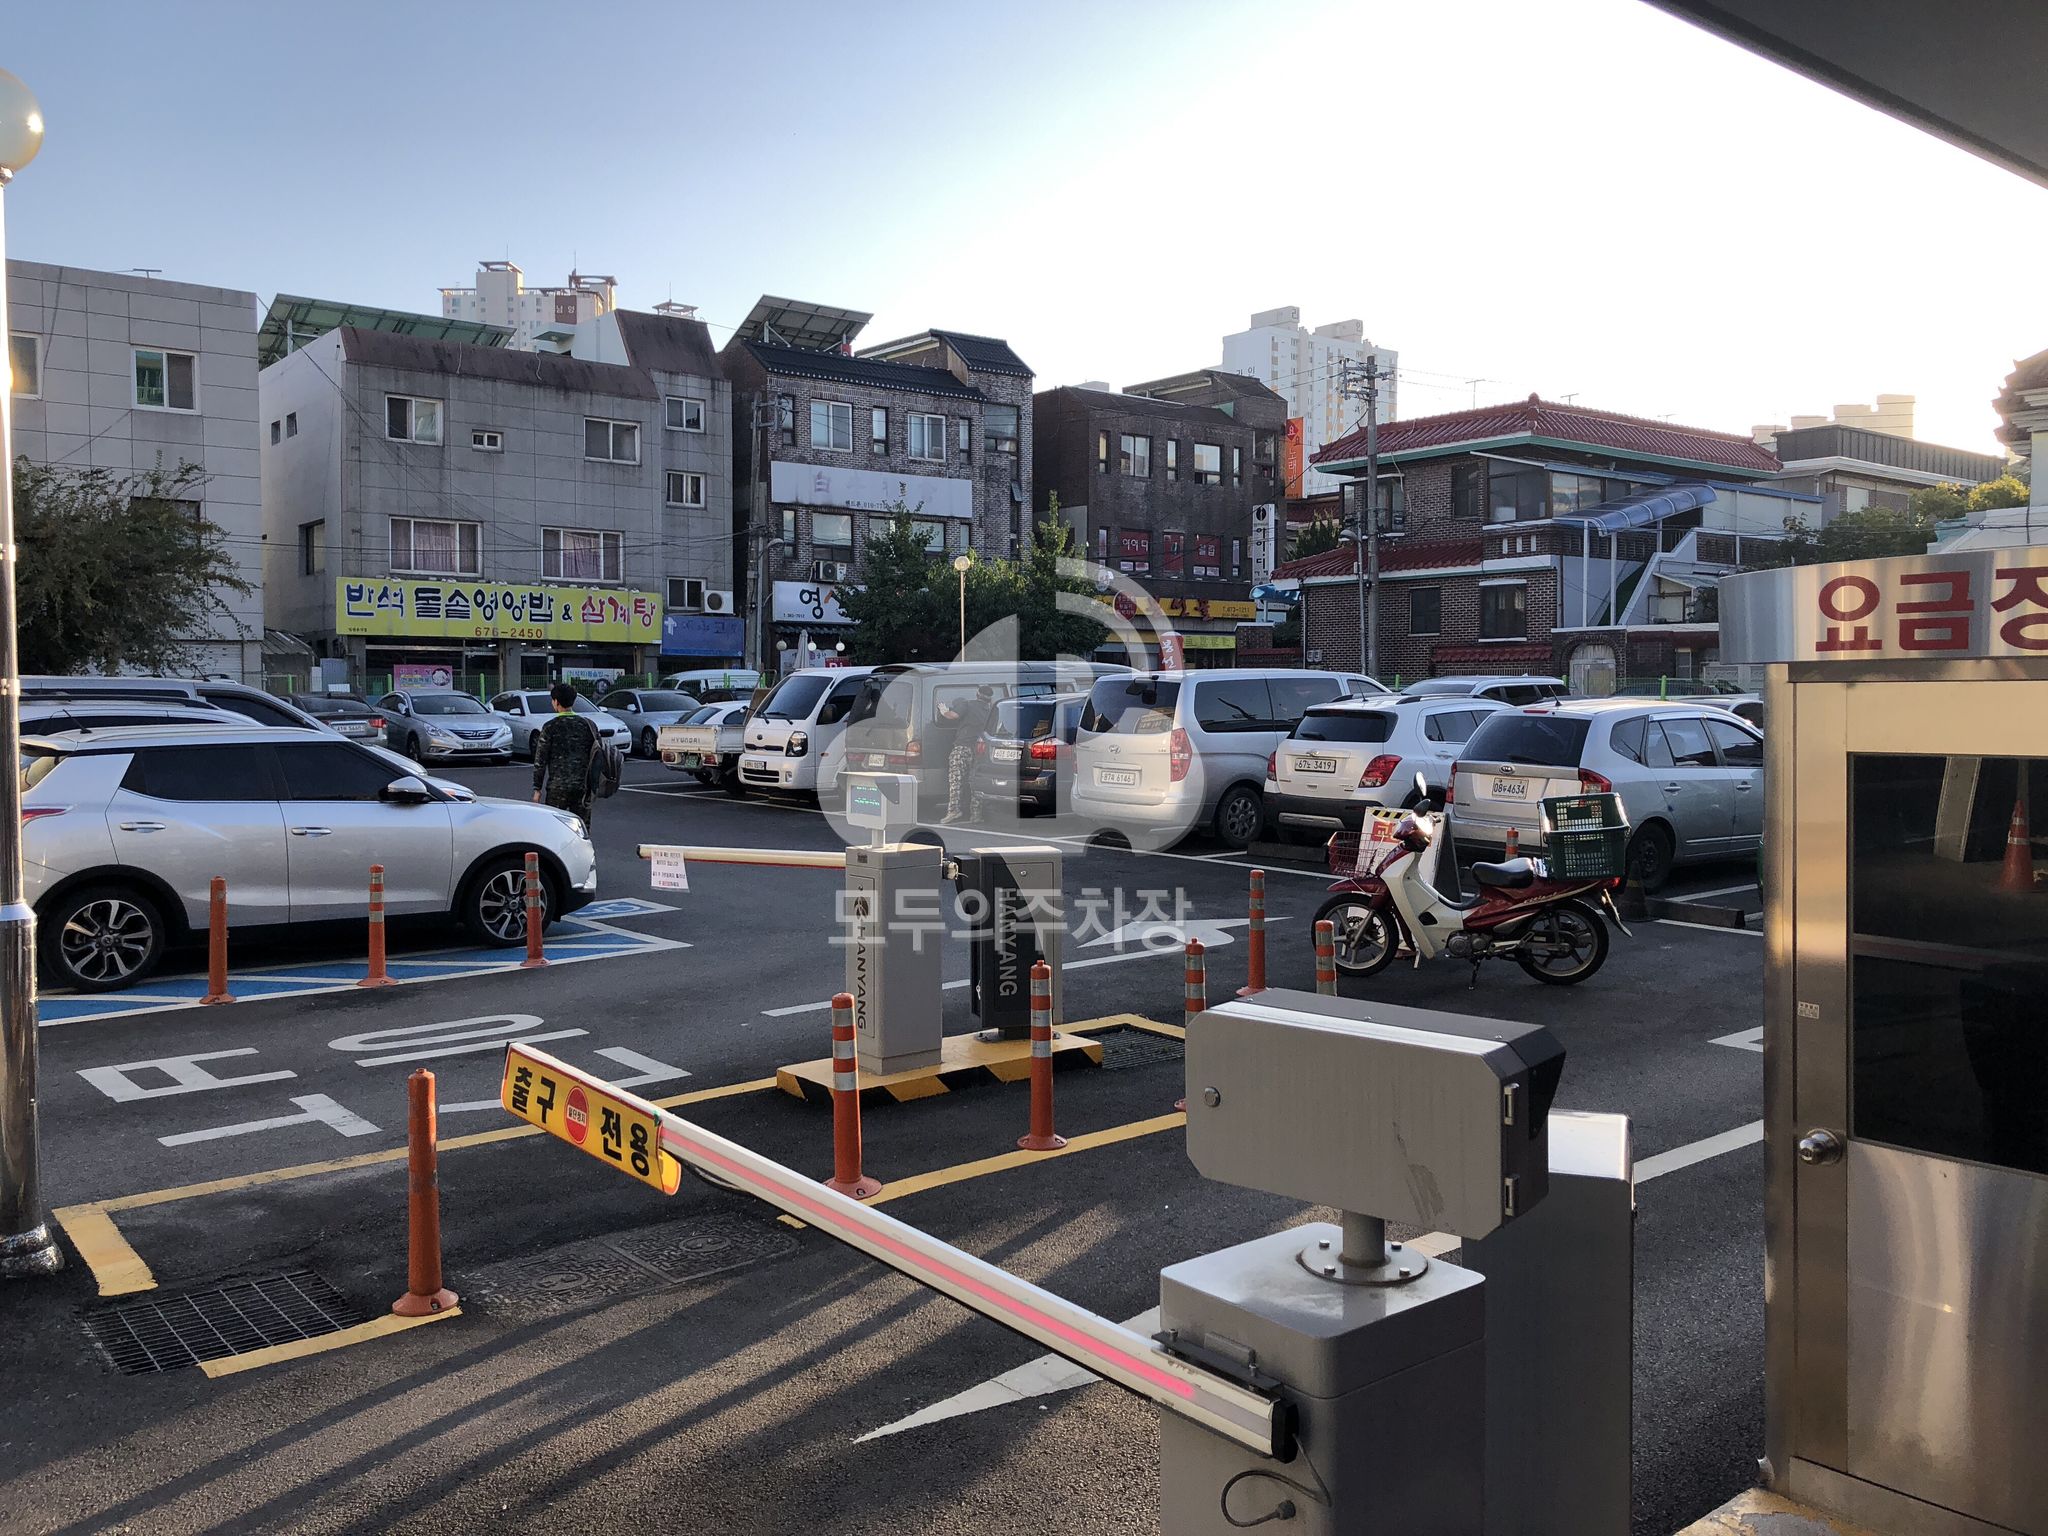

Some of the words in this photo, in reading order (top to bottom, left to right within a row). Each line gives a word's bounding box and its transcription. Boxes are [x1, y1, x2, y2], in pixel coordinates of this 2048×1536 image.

[346, 583, 404, 617] 반석
[561, 603, 574, 622] &
[581, 595, 656, 628] 삼계탕
[474, 627, 543, 639] 676-2450
[1313, 760, 1332, 770] 3419
[855, 925, 868, 1031] HANYANG
[1000, 887, 1018, 997] HANYANG
[512, 1066, 557, 1125] 출구
[600, 1106, 650, 1177] 전용
